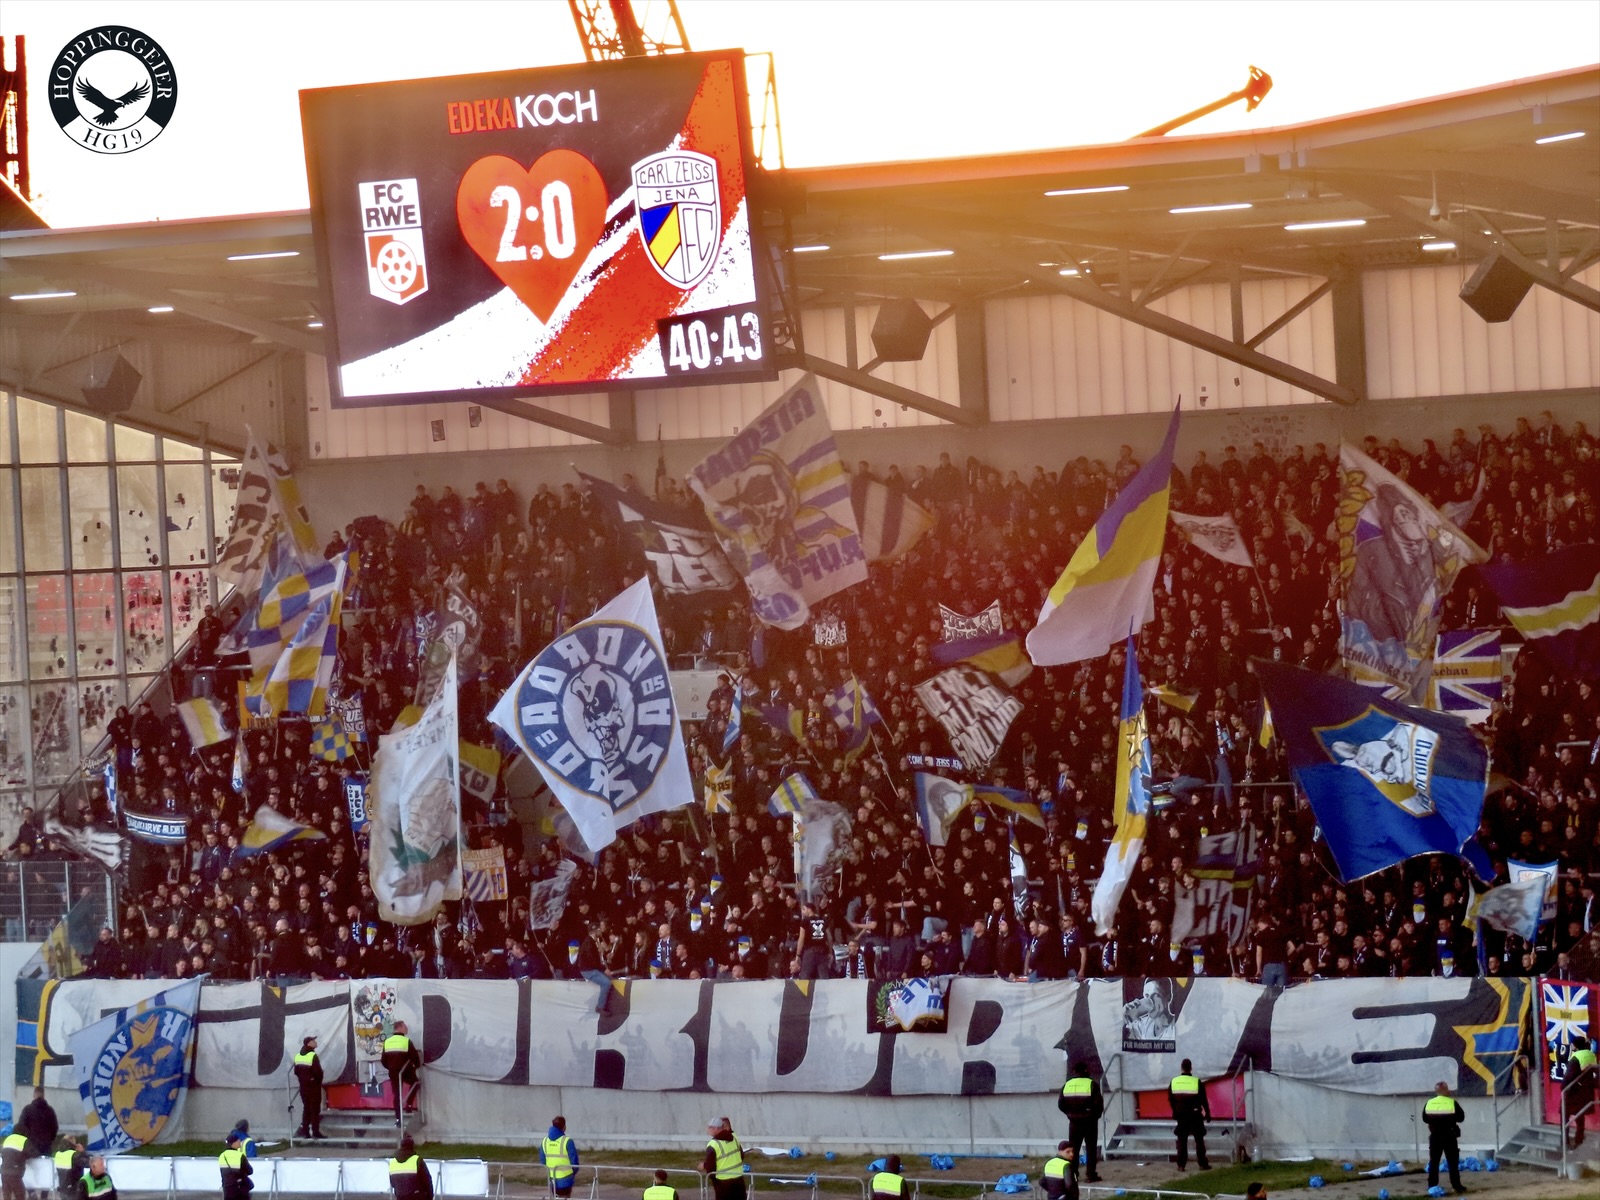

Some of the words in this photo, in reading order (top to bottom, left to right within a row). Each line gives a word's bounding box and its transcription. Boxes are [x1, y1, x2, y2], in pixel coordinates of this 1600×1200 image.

[447, 97, 517, 135] EDEKA
[514, 89, 598, 128] KOCH
[373, 183, 404, 204] FC
[653, 187, 700, 203] JENA
[365, 204, 418, 228] RWE
[490, 179, 577, 263] 2:0
[669, 312, 763, 371] 40:43
